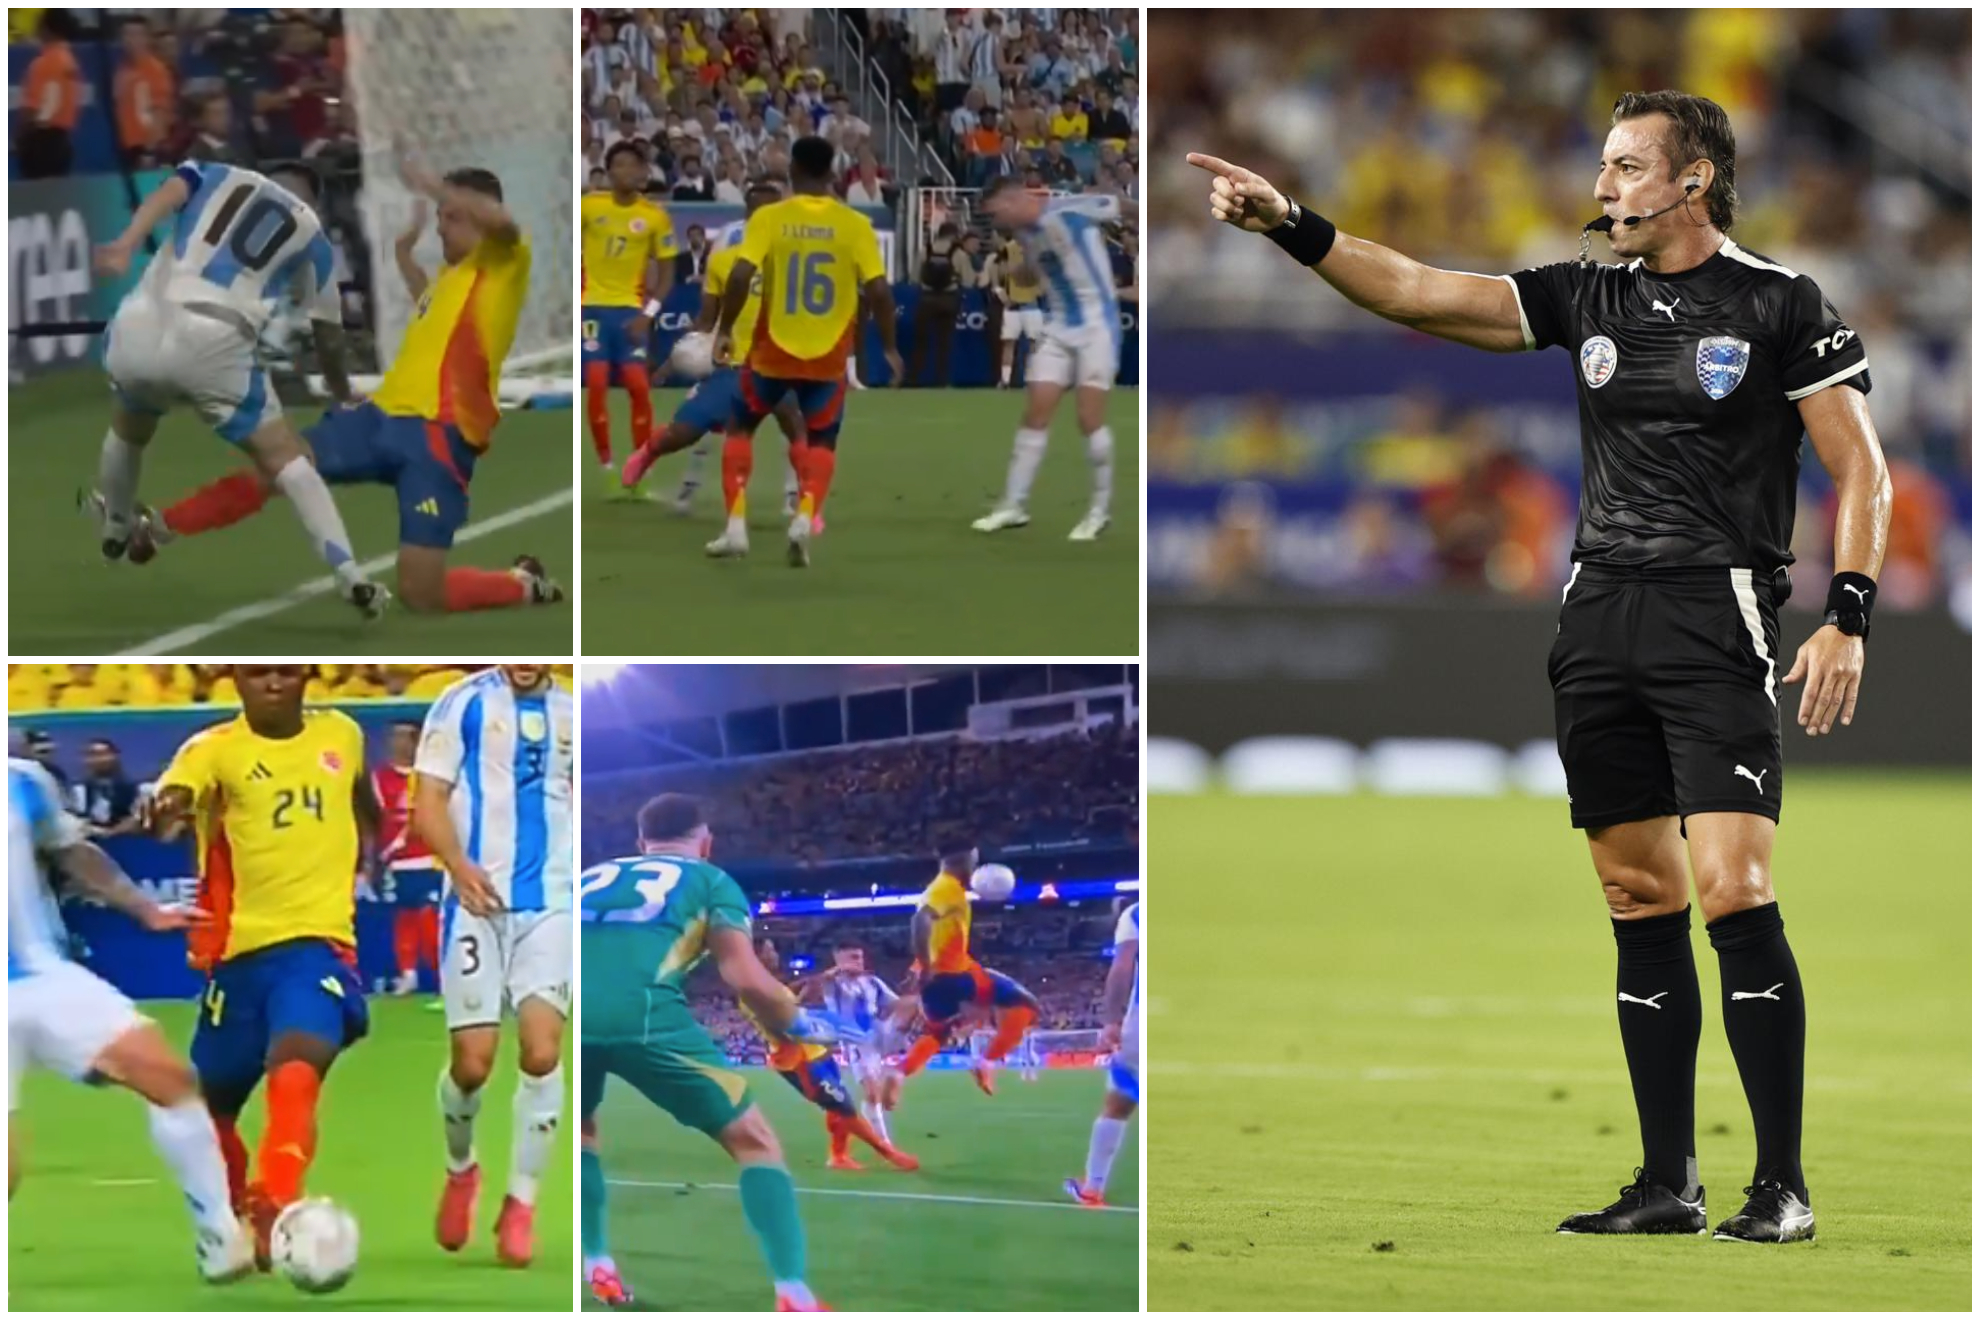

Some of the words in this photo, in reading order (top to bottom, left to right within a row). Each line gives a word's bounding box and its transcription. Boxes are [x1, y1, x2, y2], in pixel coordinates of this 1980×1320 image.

[203, 184, 297, 272] 10
[605, 235, 627, 258] 17
[785, 251, 836, 316] 16
[517, 745, 547, 786] 3
[273, 784, 323, 830] 24
[581, 862, 682, 922] 23
[458, 934, 481, 976] 3
